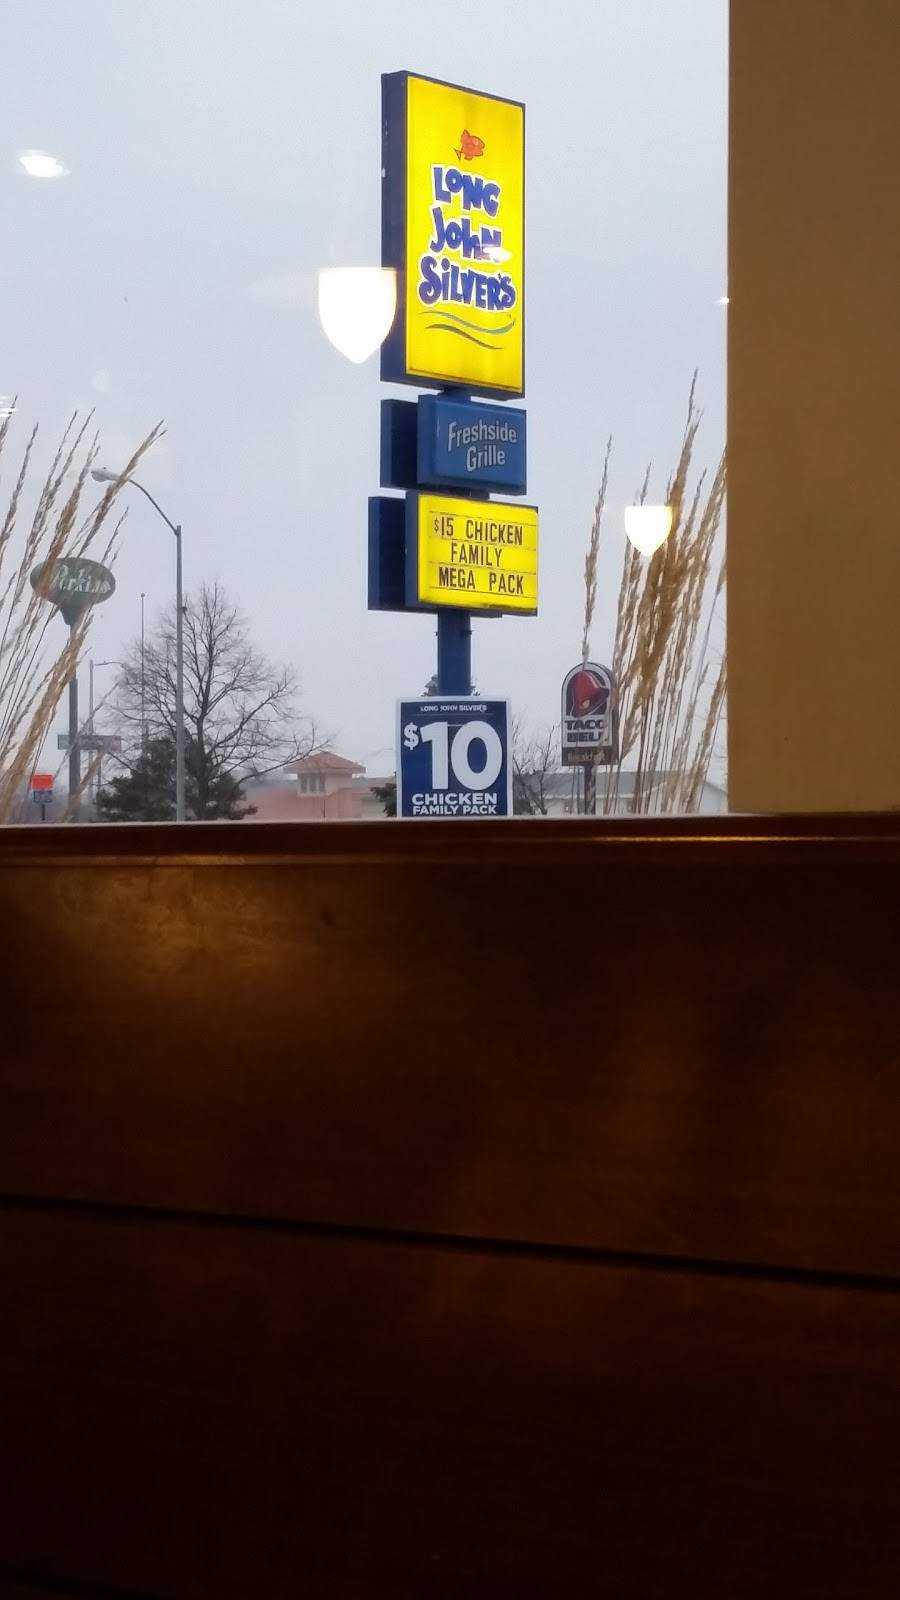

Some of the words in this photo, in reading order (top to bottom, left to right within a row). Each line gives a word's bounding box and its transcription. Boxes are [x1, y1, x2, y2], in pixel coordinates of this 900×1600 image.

[432, 166, 501, 217] LONG
[447, 419, 518, 452] Freshside
[466, 444, 506, 472] Grille
[433, 516, 454, 537] $15
[465, 519, 523, 546] CHICKEN
[451, 542, 503, 568] FAMILY
[438, 566, 476, 590] MEGA
[489, 573, 524, 595] PACK
[420, 704, 439, 712] LONG
[440, 704, 458, 712] JOHN
[403, 720, 503, 791] $10
[411, 792, 498, 805] CHICKEN
[412, 805, 460, 816] FAMILY
[462, 804, 497, 815] PACK
